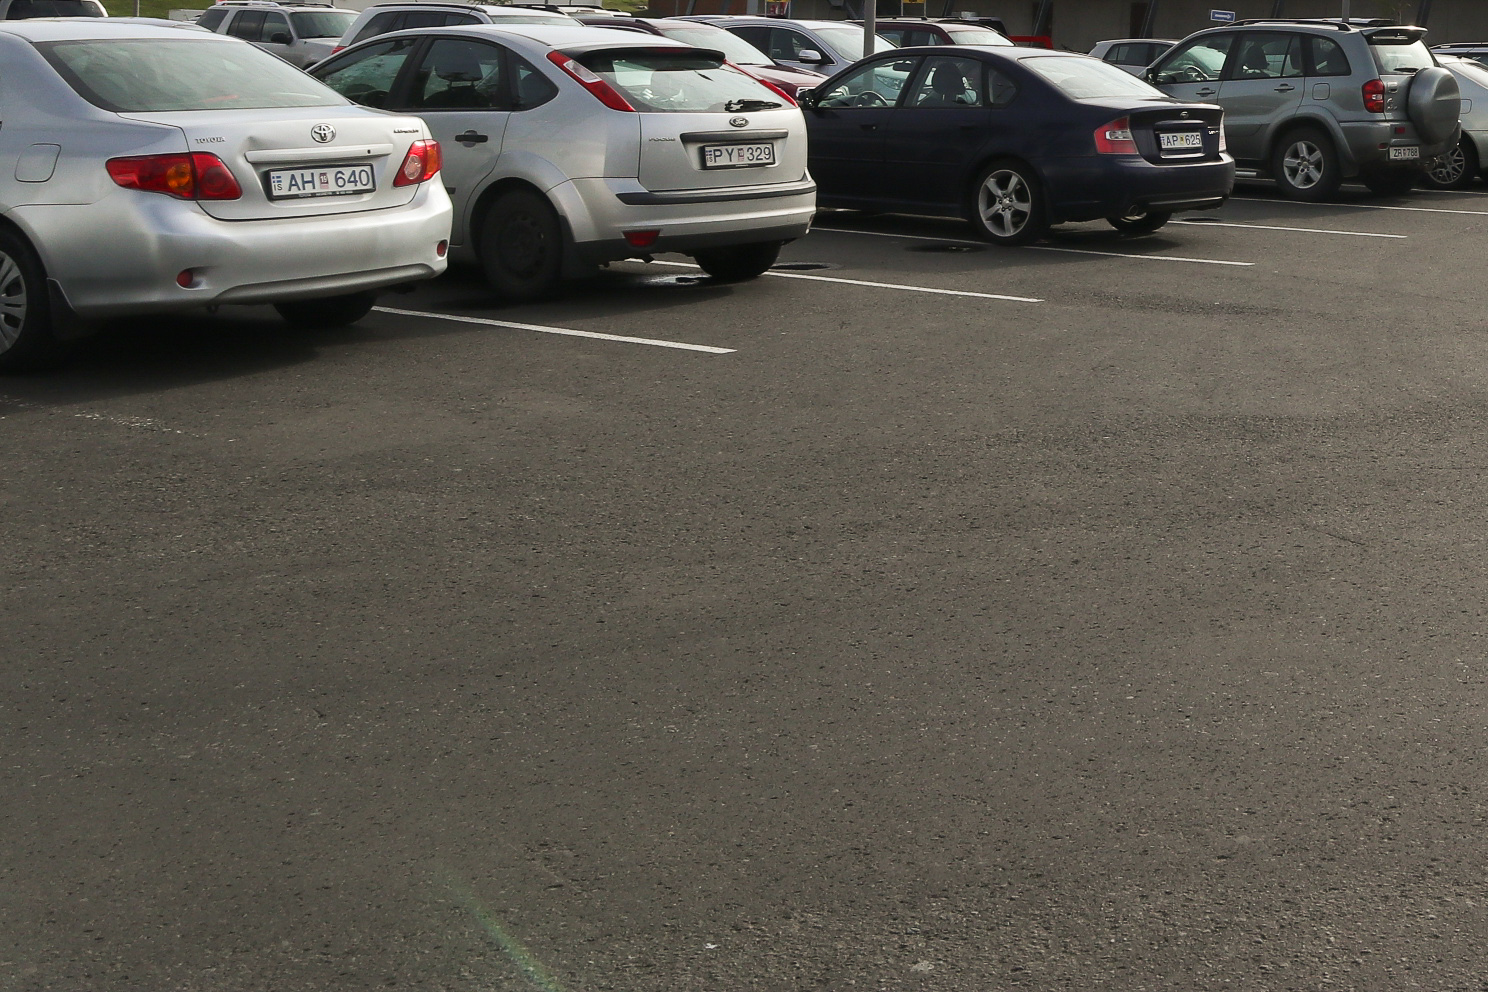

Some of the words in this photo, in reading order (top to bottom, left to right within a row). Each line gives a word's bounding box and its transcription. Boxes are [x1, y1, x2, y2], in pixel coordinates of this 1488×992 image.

[1166, 135, 1178, 146] AP
[1185, 134, 1201, 146] 625
[713, 148, 735, 163] PY
[746, 146, 771, 161] 329
[273, 183, 283, 191] IS
[287, 173, 316, 192] AH
[334, 169, 370, 188] 640
